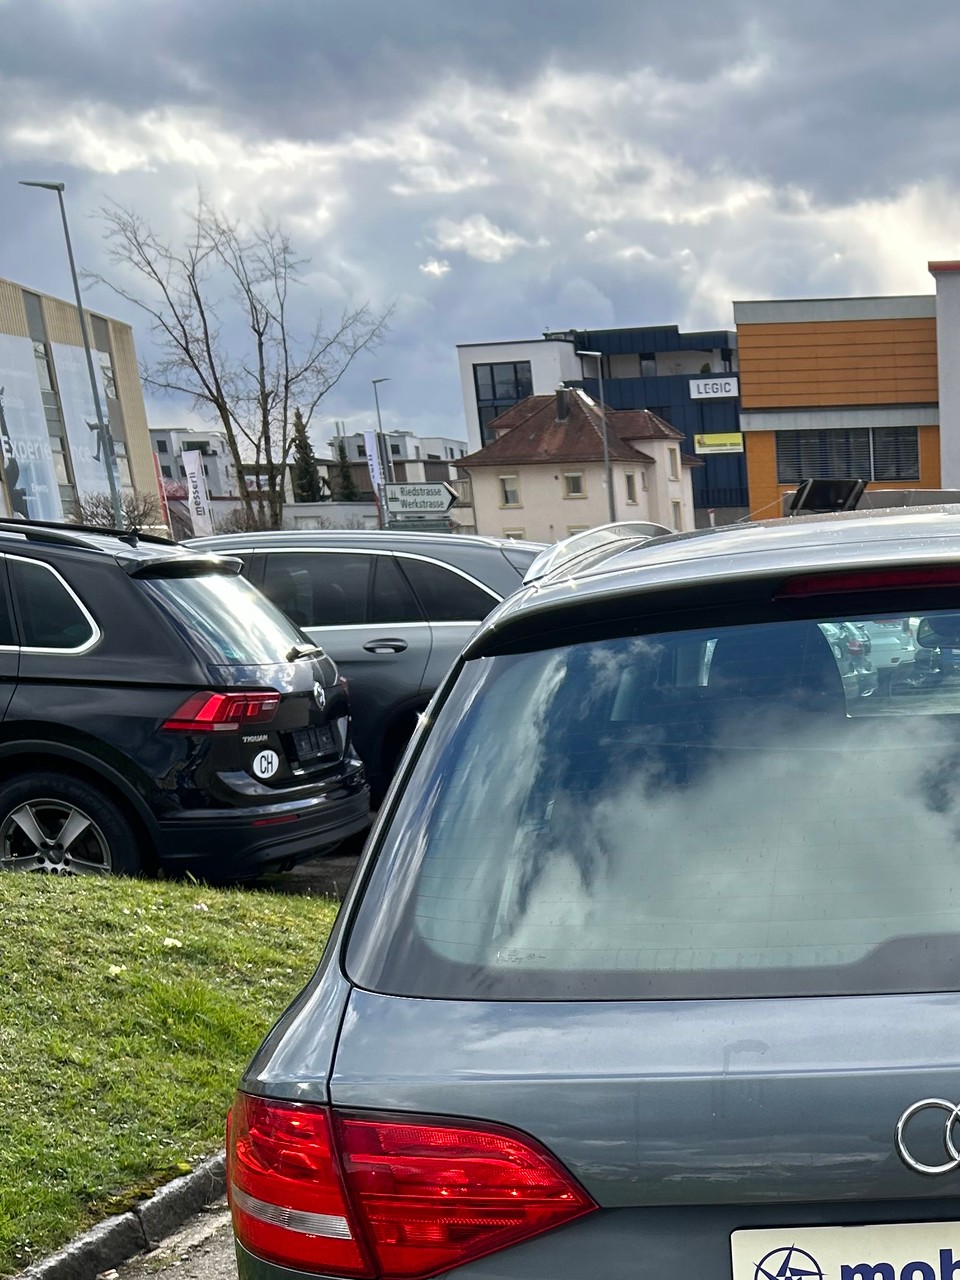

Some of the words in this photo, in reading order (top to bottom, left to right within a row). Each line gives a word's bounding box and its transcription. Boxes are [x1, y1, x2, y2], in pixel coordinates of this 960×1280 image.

[696, 382, 732, 395] LEGIC
[188, 471, 204, 516] messerli
[399, 486, 442, 497] Riedstrasse
[400, 499, 445, 509] Werkstrasse
[259, 753, 274, 774] CH
